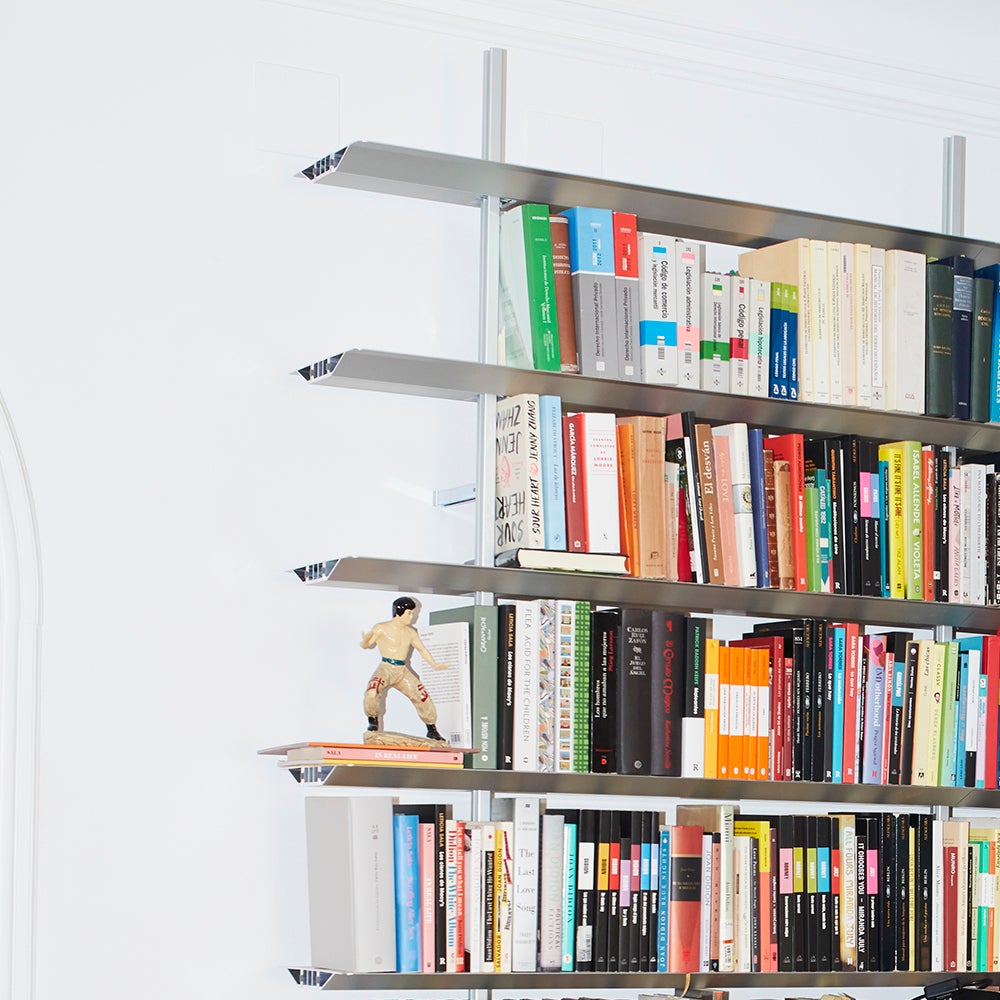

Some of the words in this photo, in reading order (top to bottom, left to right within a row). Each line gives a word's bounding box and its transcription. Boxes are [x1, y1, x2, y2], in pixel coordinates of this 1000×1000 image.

[659, 260, 669, 282] Código
[659, 283, 669, 291] de
[660, 292, 669, 319] comercio
[737, 303, 746, 328] Código
[755, 307, 765, 336] Legislación
[755, 336, 765, 365] hipotecaria
[527, 400, 536, 430] ZHANG
[529, 432, 538, 461] JENNY
[569, 423, 577, 446] GARCÍA
[569, 446, 578, 476] MÁRQUEZ
[702, 441, 713, 480] desván
[913, 450, 921, 482] ISABEL
[529, 476, 540, 508] HEART
[703, 483, 714, 494] El
[913, 483, 921, 524] ALLENDE
[496, 520, 523, 547] SOUR
[531, 508, 541, 534] SOUR
[913, 541, 921, 580] VIOLETA
[523, 679, 531, 696] THE
[522, 698, 530, 742] CHILDREN
[447, 830, 457, 863] Didion
[519, 848, 535, 858] The
[518, 866, 535, 876] Last
[845, 847, 854, 875] FOURS
[516, 884, 536, 894] Love
[515, 903, 536, 915] Song
[845, 924, 854, 945] JULY
